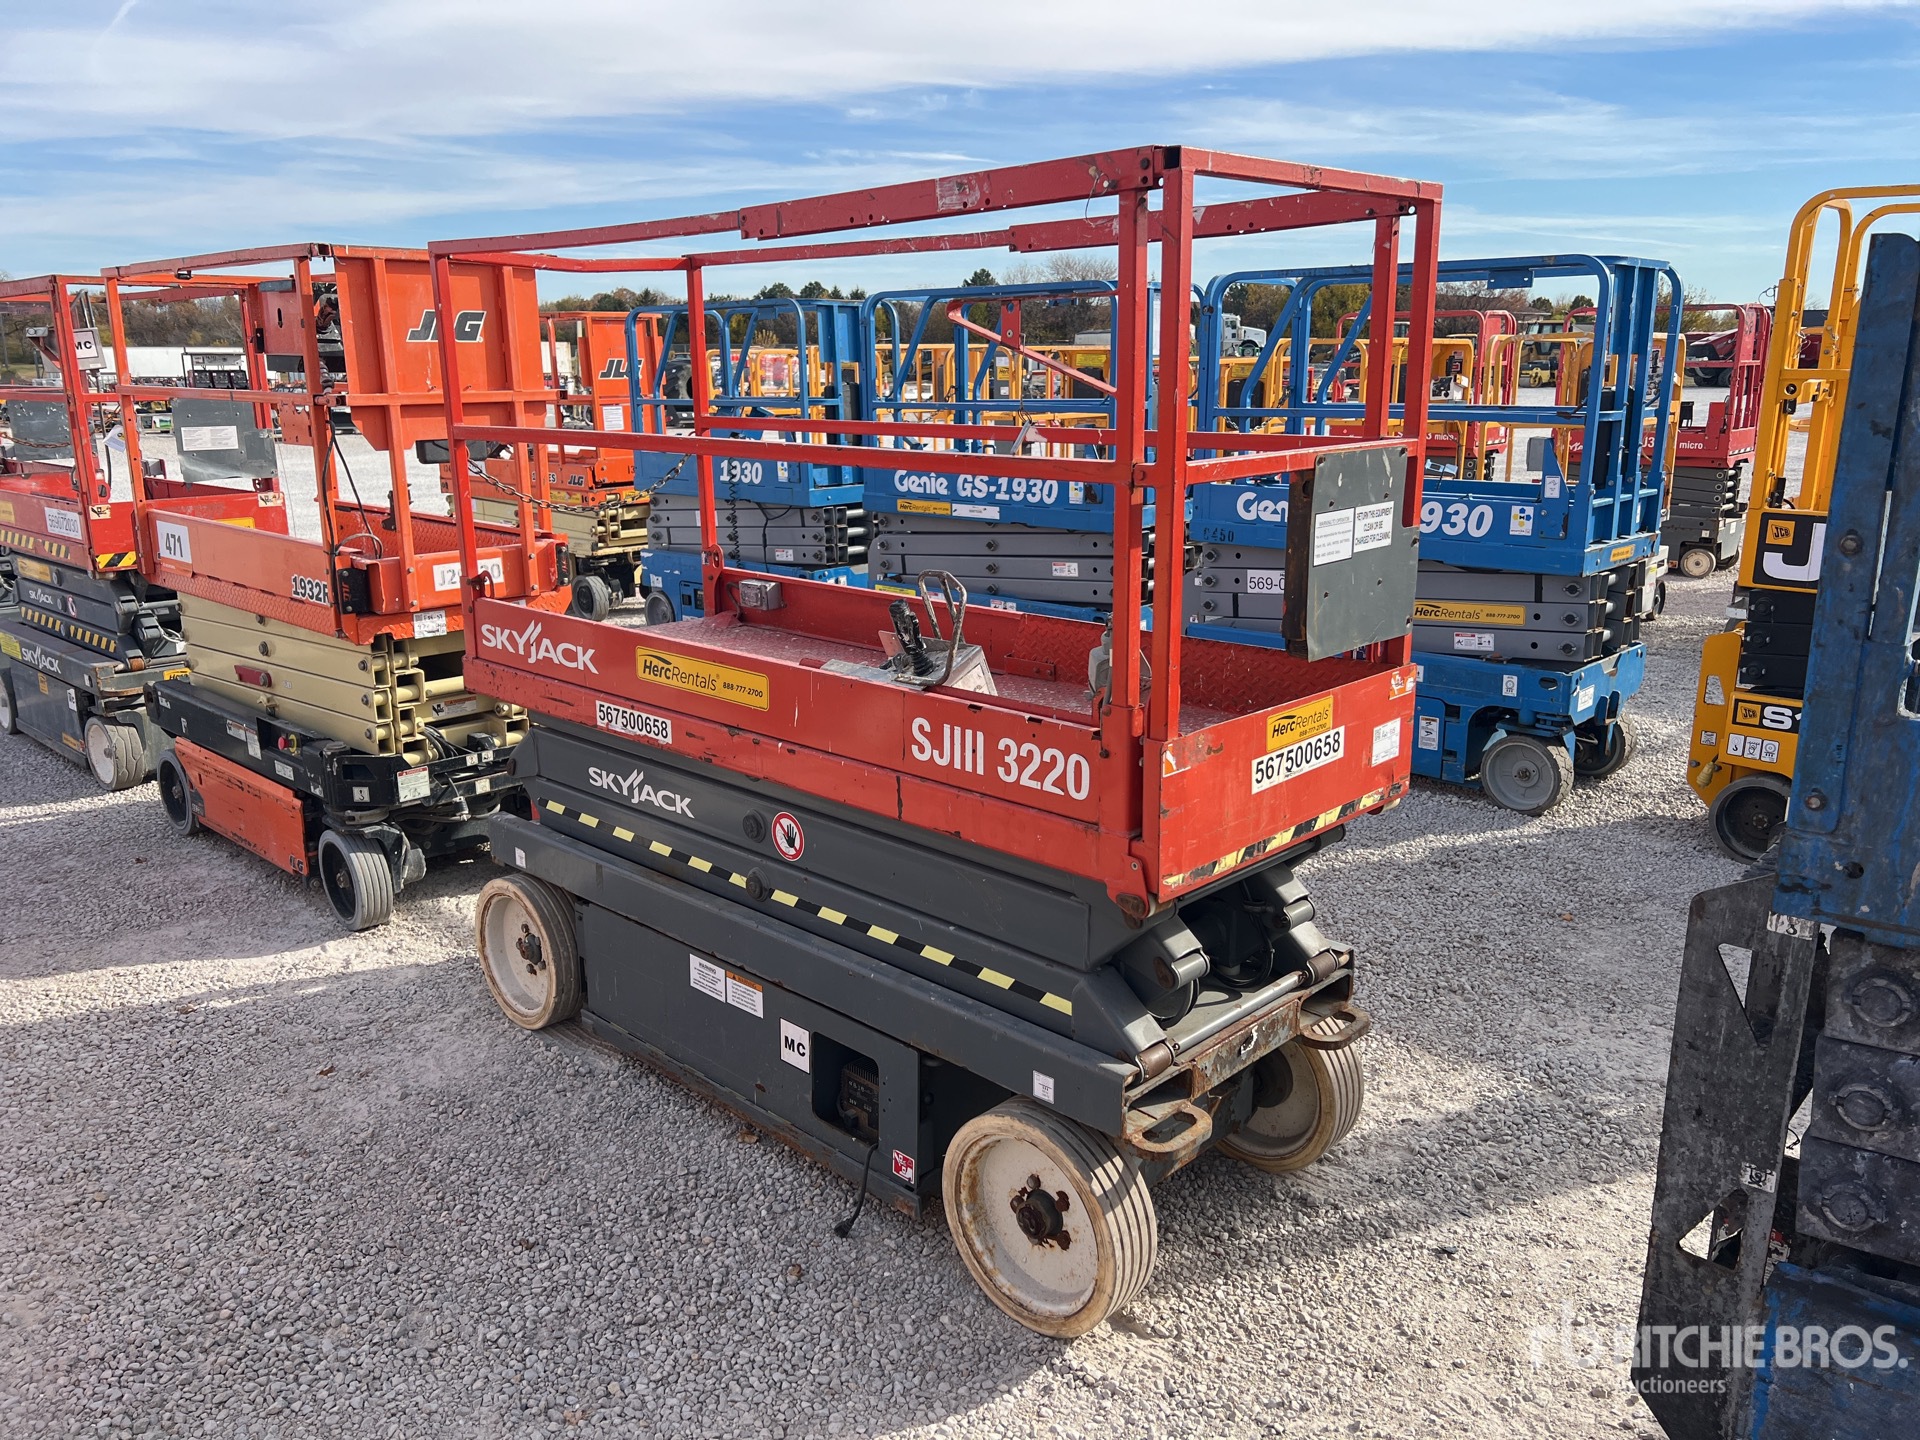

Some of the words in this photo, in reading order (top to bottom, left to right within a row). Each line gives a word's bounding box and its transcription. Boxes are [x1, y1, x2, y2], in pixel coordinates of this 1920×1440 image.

[406, 310, 488, 343] JG
[1679, 441, 1704, 450] micro
[567, 474, 585, 488] JLG
[720, 460, 763, 485] 1930
[893, 469, 948, 496] Genie
[956, 474, 1059, 506] GS-1930
[1236, 491, 1289, 523] Gen
[1419, 501, 1494, 538] 930
[165, 532, 184, 558] 471
[1774, 526, 1791, 538] JCB
[1414, 606, 1481, 620] HercRentals
[21, 645, 62, 675] SKYJACK
[480, 620, 600, 675] SKYJACK
[642, 658, 718, 692] HercRentals
[722, 681, 764, 698] 888-777-2700
[597, 703, 669, 739] 567500658
[1271, 704, 1329, 739] HercRentals
[911, 717, 985, 775] SJIII
[997, 737, 1091, 802] 3220
[1254, 730, 1341, 784] 567500658
[588, 765, 695, 819] SKYJACK
[784, 1034, 806, 1057] MC
